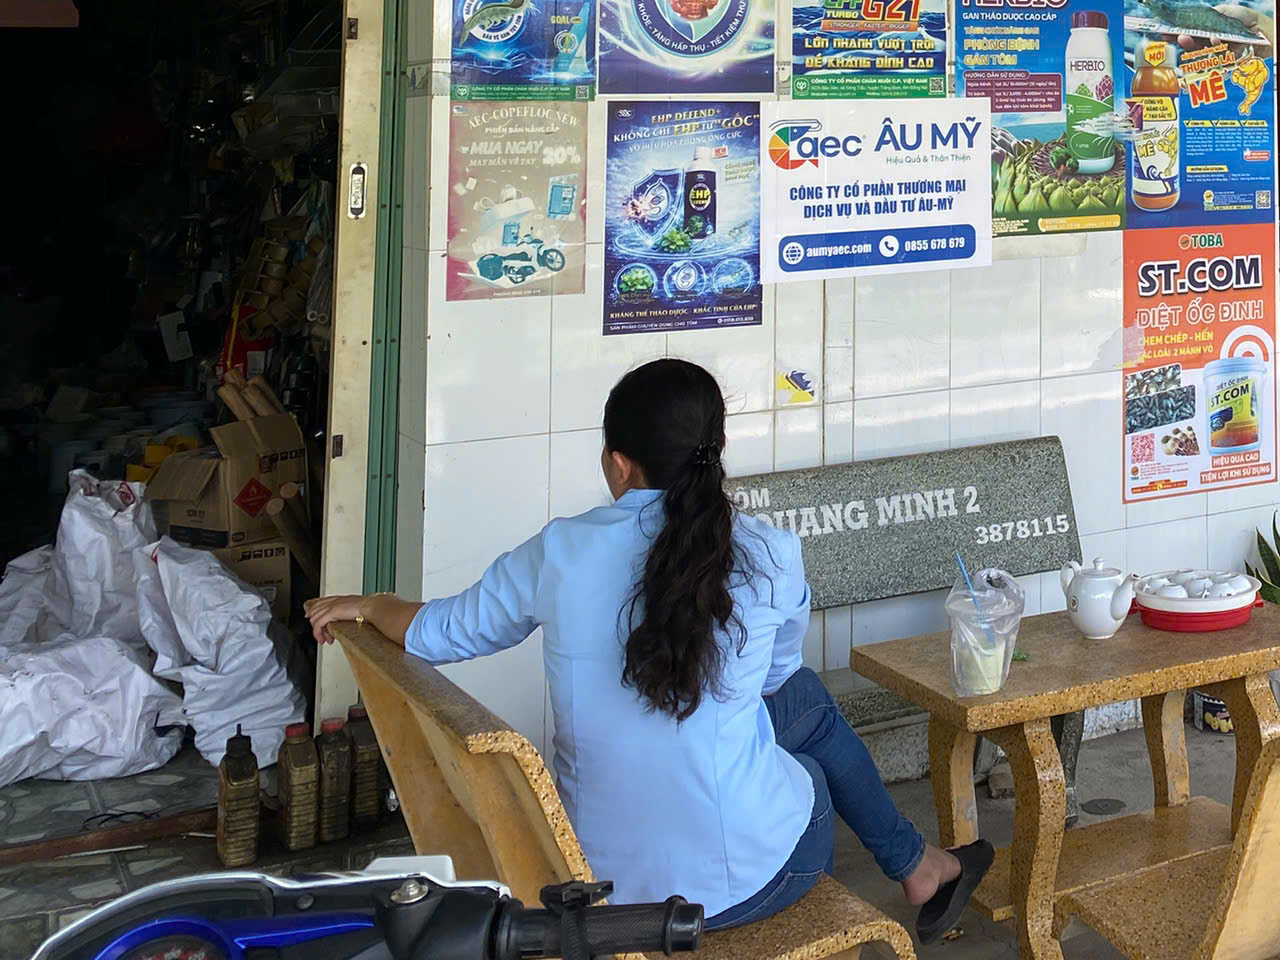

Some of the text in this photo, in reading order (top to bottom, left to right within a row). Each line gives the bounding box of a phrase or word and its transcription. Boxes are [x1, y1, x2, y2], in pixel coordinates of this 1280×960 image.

[826, 10, 859, 19] TURBO
[833, 38, 873, 49] NHANH
[908, 57, 934, 68] CAO
[1070, 60, 1105, 72] HERBIO
[1189, 71, 1227, 107] MÊ
[651, 114, 673, 125] EHP
[673, 121, 701, 136] EHP
[796, 116, 982, 159] aec ÂU MỸ
[470, 141, 543, 156] MUA NGAY
[886, 156, 904, 165] Hiệu
[905, 154, 921, 164] Quả
[923, 155, 929, 163] &
[950, 153, 971, 163] Thiện
[689, 189, 711, 201] EHP
[789, 178, 967, 201] CÔNG TY CỔ PHẦN THƯƠNG MẠI
[803, 194, 954, 222] DỊCH VỤ VÀ ĐẦU TƯ ÂU-MỸ
[806, 236, 965, 259] aumyaec.com 0855 678 679
[1191, 234, 1224, 248] TOBA
[1138, 255, 1263, 297] ST.COM
[1137, 297, 1264, 330] DIỆT ỐC ĐINH
[1164, 331, 1188, 344] CHÉP
[1195, 328, 1213, 341] HẾN
[1174, 348, 1178, 356] 2
[1210, 383, 1250, 408] ST.COM
[1245, 453, 1258, 462] CAO
[1230, 470, 1241, 479] KHI
[875, 489, 957, 527] MINH
[964, 486, 980, 514] 2
[975, 514, 1070, 545] 3878115
